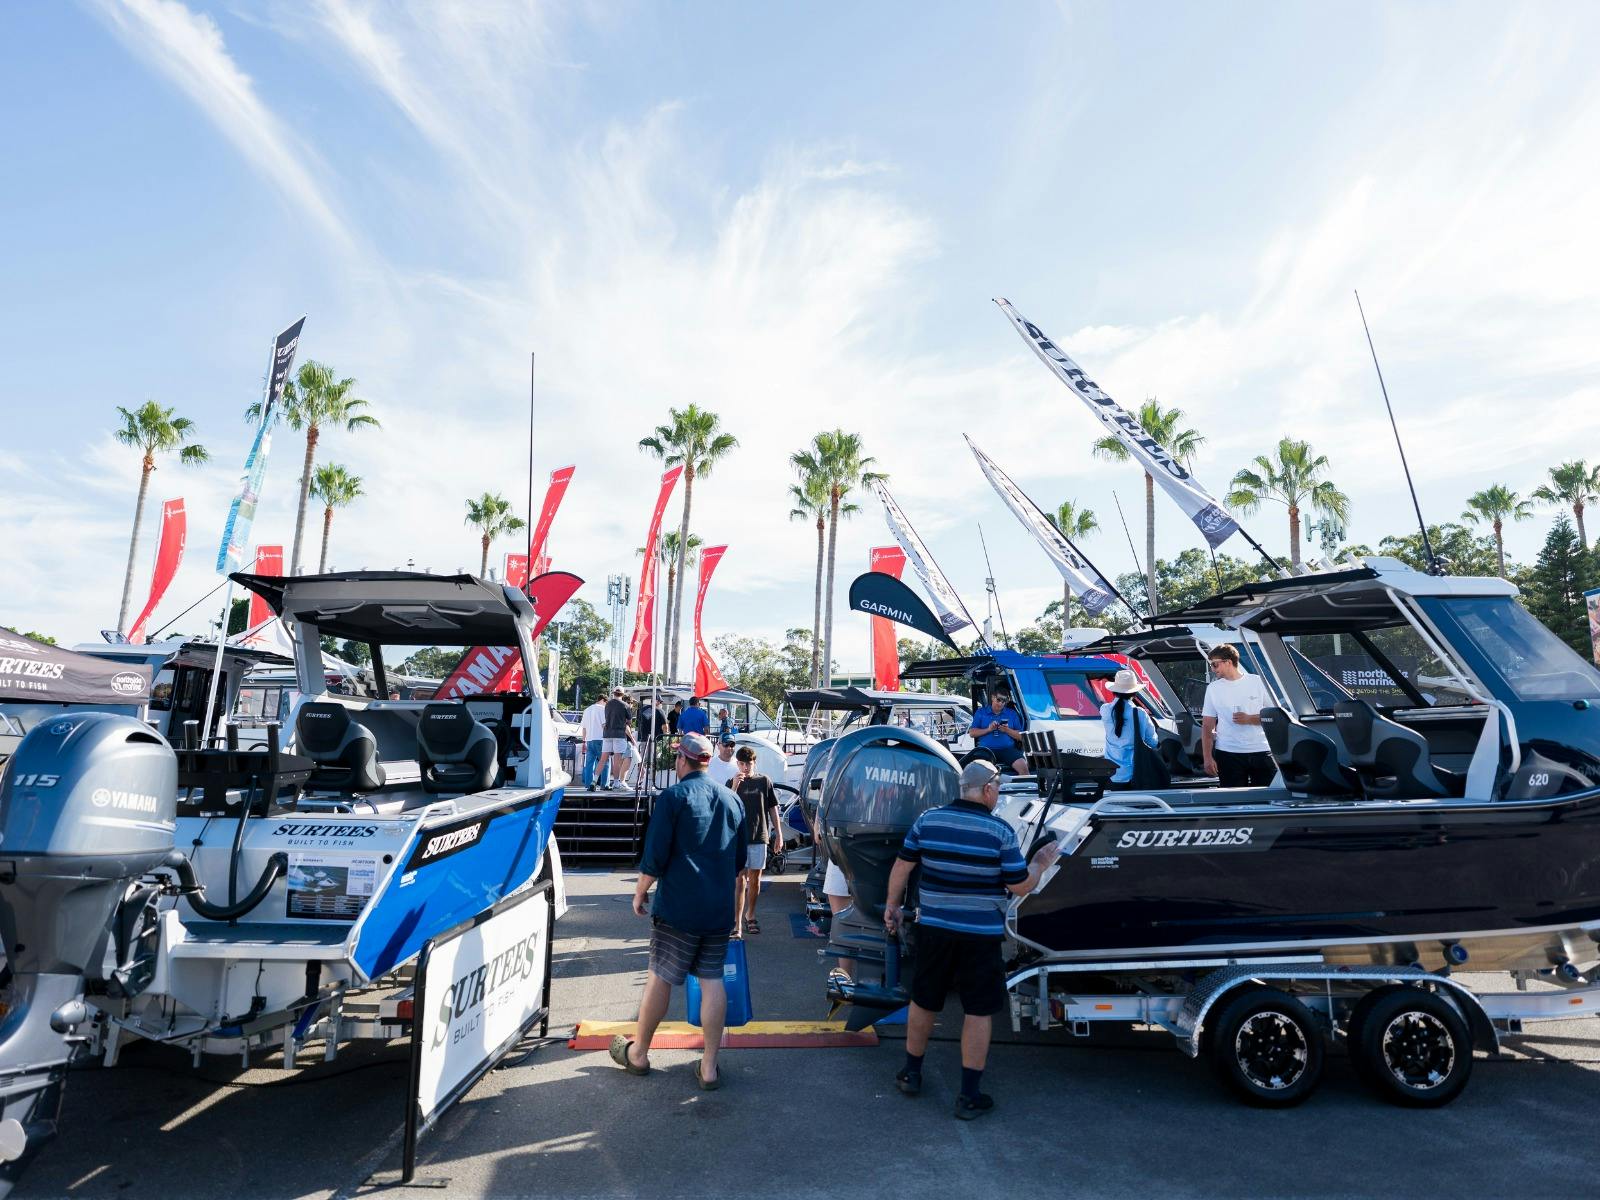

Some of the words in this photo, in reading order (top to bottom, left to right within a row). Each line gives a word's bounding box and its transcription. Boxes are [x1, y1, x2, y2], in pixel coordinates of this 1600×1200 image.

[860, 599, 913, 624] GARMIN
[15, 680, 26, 689] TO
[28, 681, 48, 691] FISH
[13, 774, 61, 787] 115
[864, 766, 917, 787] YAMAHA
[1528, 773, 1549, 786] 620
[112, 791, 157, 813] YAMAHA
[272, 823, 379, 838] SURTEES
[421, 822, 482, 859] SURTEES
[1116, 828, 1254, 848] SURTEES
[431, 931, 540, 1053] SURTEES
[453, 1012, 482, 1045] BUILT
